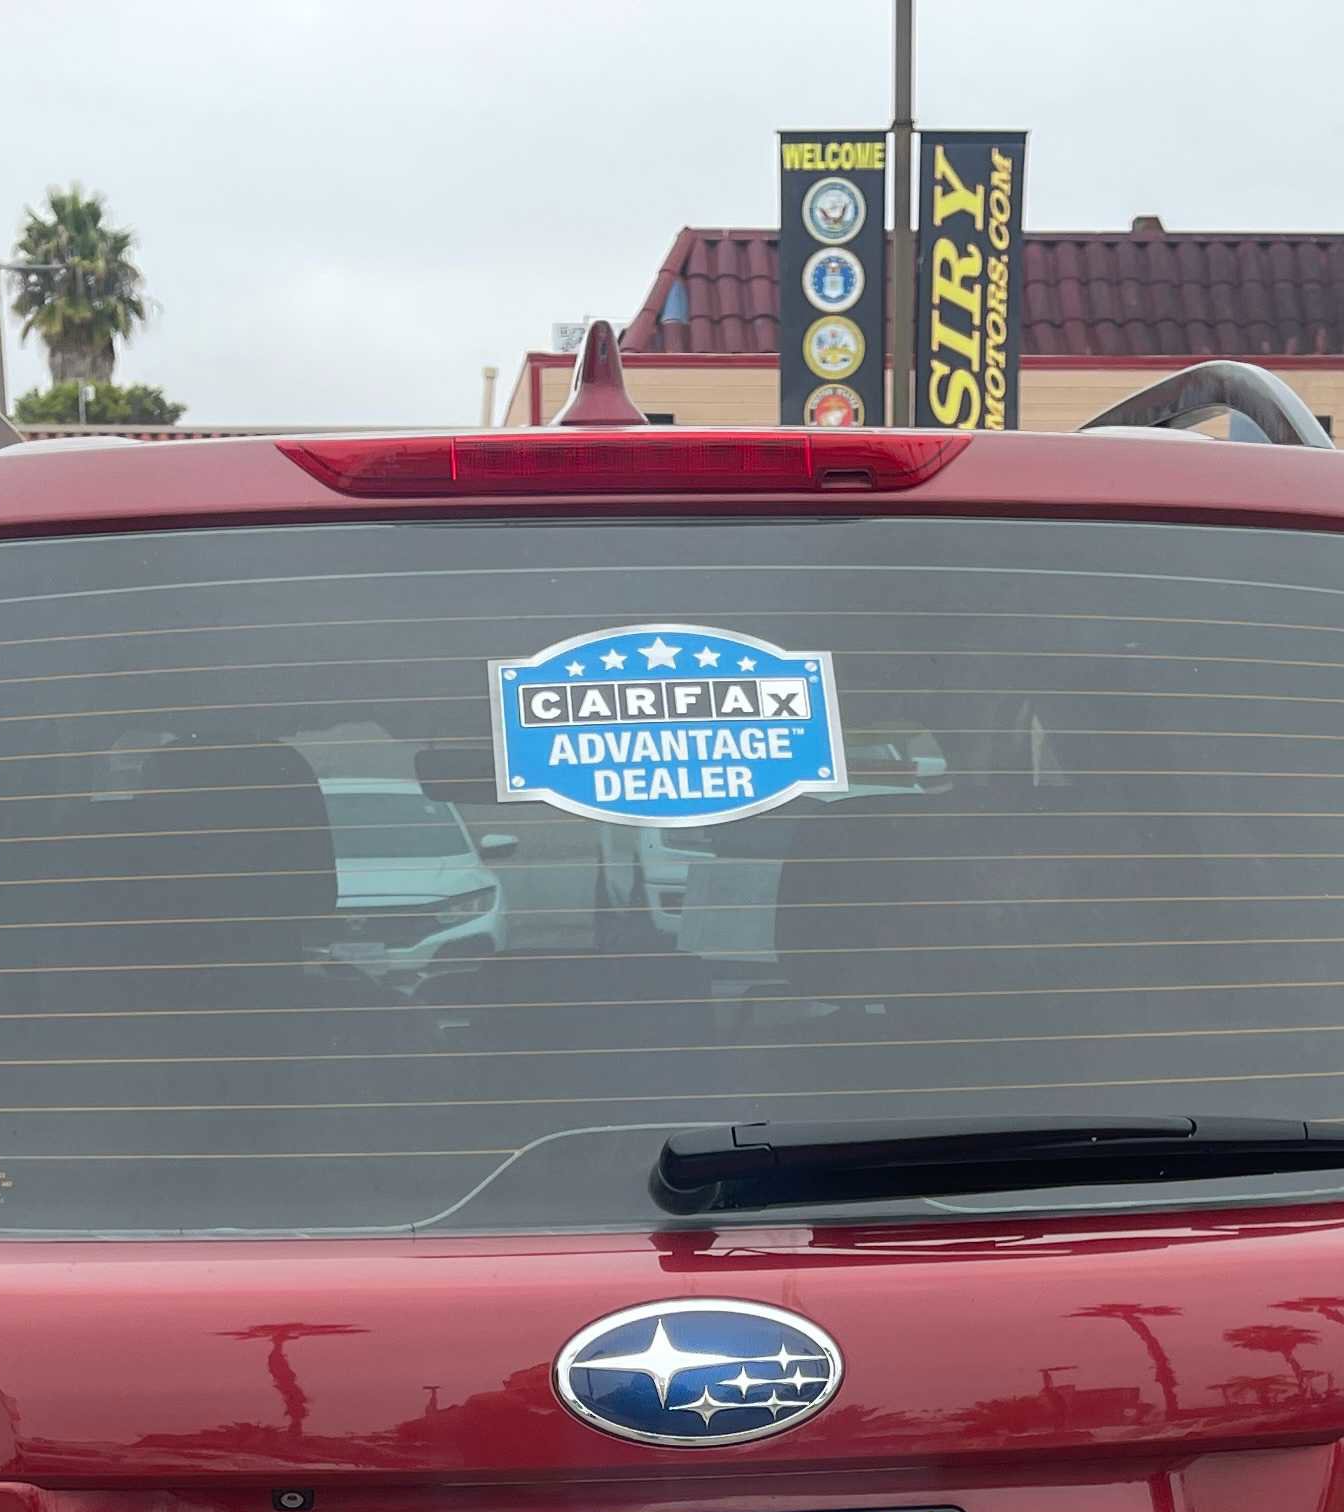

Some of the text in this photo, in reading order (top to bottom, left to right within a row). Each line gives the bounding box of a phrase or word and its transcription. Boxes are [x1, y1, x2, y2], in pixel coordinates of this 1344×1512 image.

[782, 142, 885, 170] WELCOME
[929, 145, 985, 429] SIRY
[984, 148, 1013, 430] MOTORS.COM
[530, 685, 802, 720] CARFAX
[594, 767, 755, 801] DEALER
